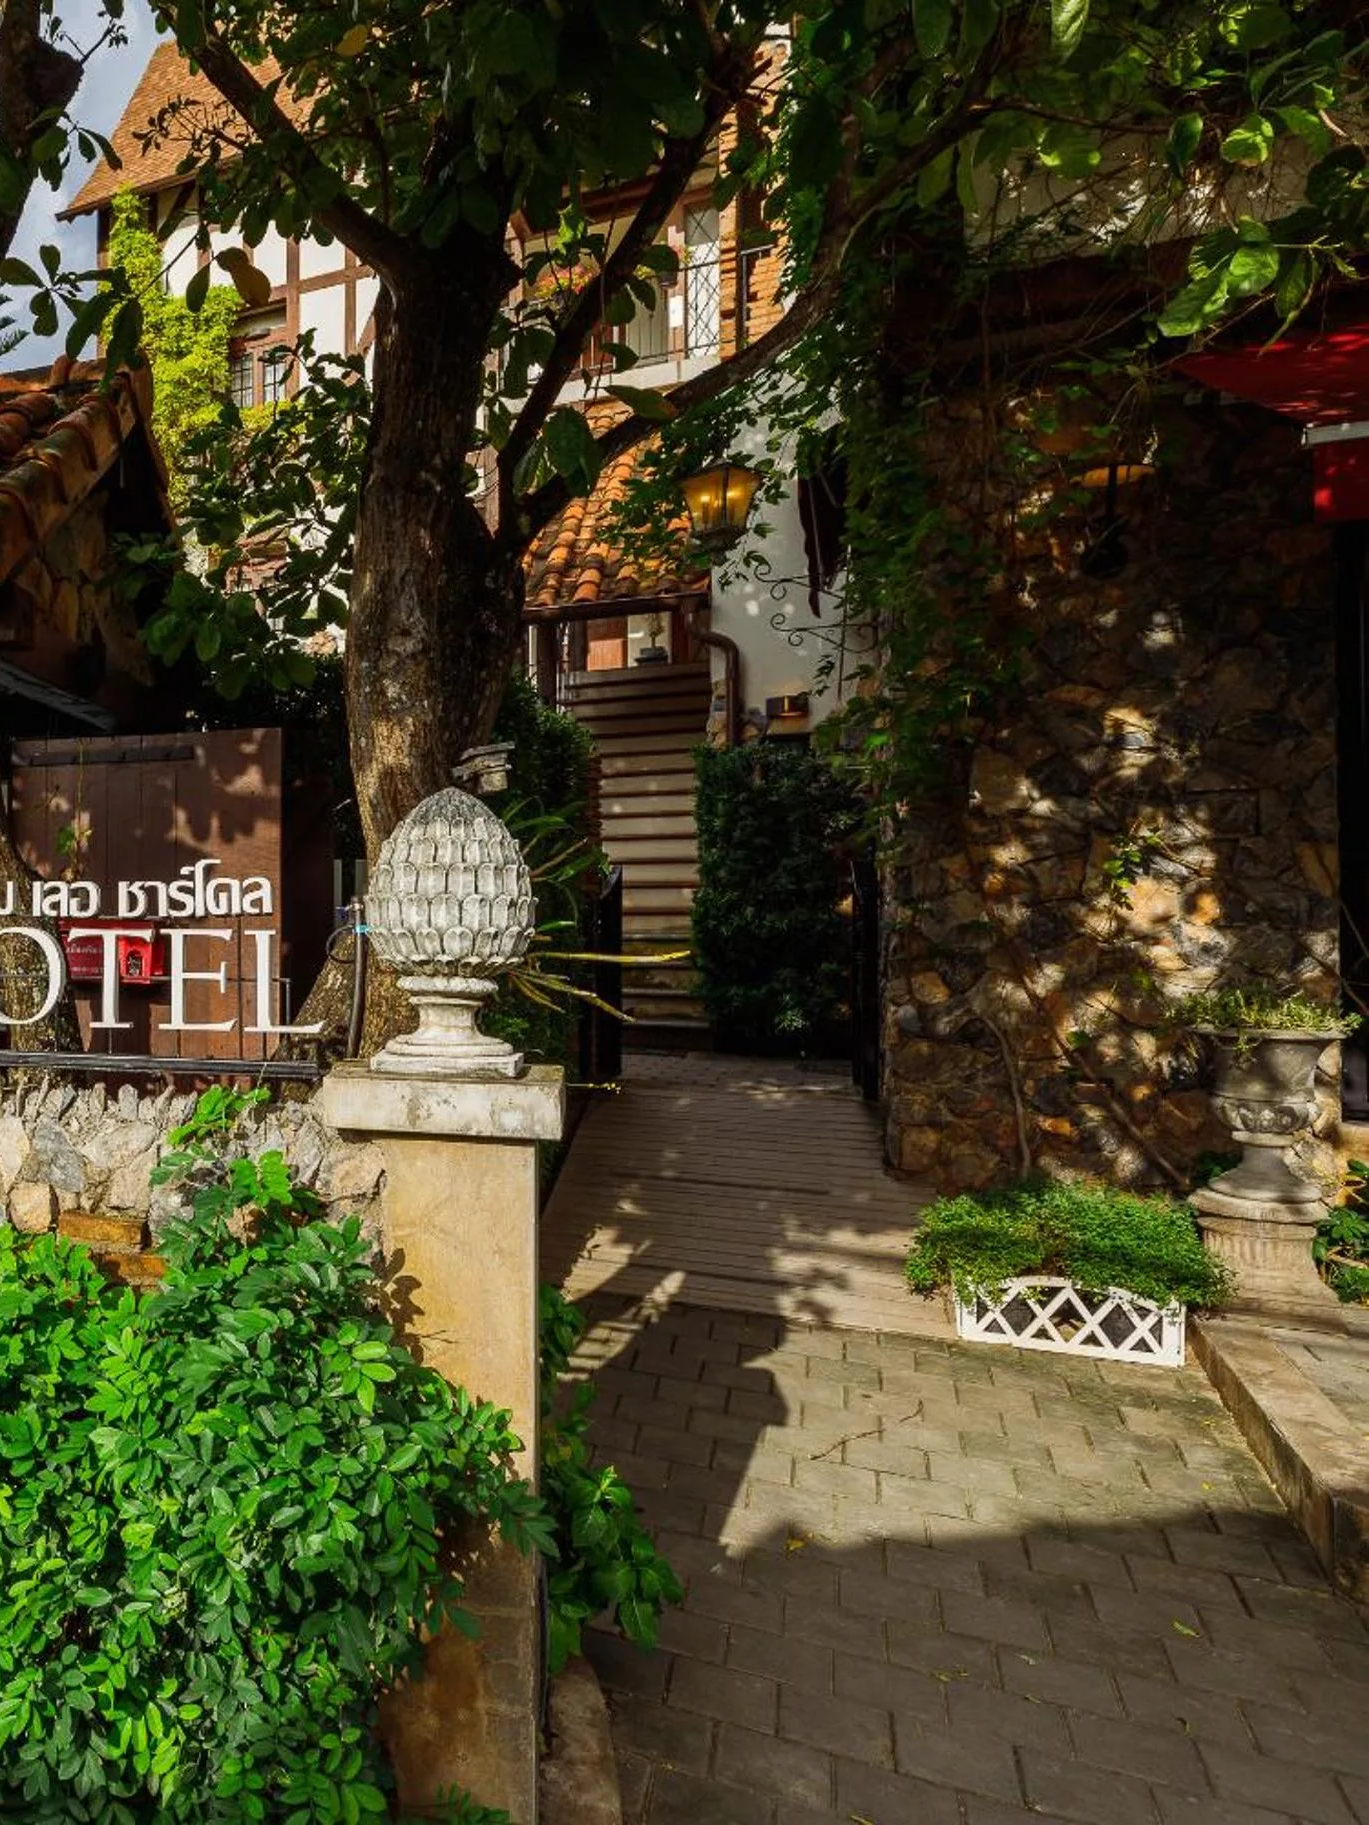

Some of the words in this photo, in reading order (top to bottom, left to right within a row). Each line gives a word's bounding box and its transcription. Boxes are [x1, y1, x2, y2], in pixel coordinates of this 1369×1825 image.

[32, 880, 101, 917] เลอ
[117, 858, 273, 918] ชาร์โคล
